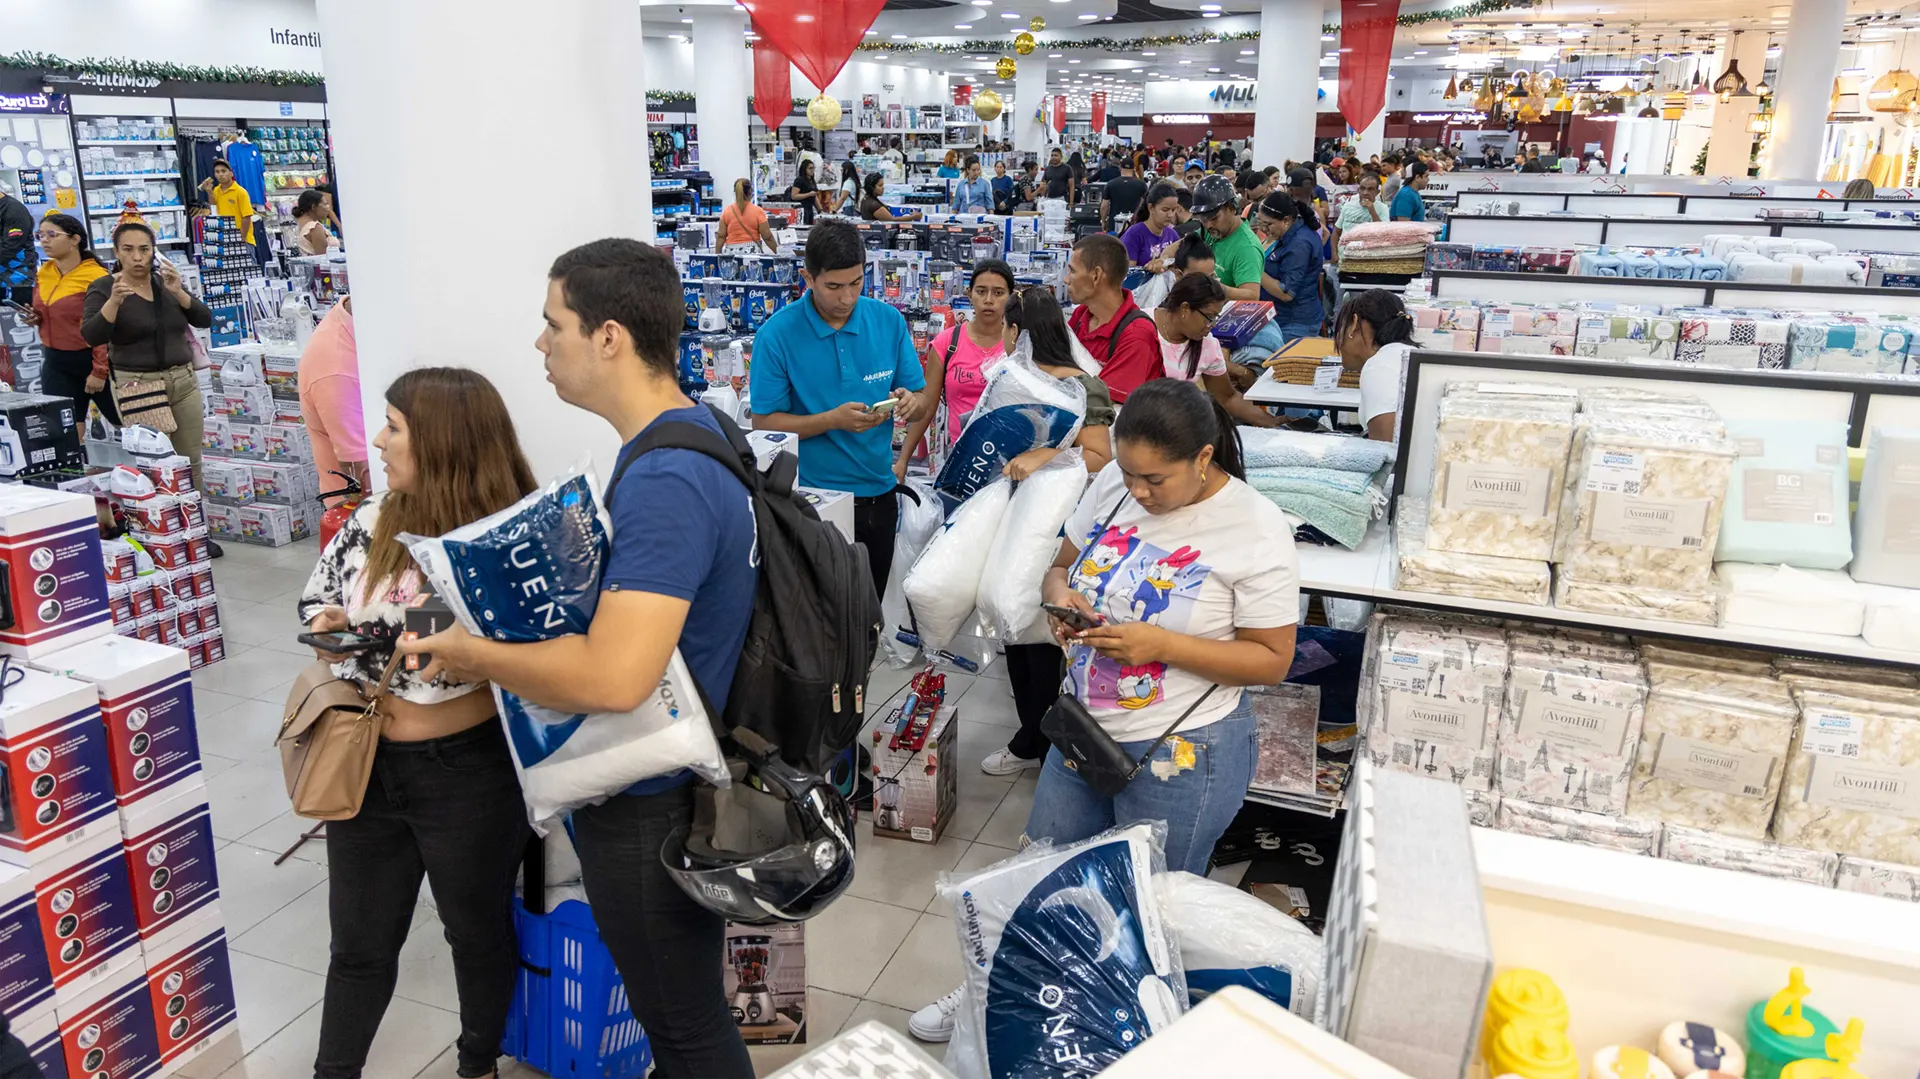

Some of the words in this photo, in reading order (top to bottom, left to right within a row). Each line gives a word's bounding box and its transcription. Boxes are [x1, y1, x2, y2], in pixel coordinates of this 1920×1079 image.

[270, 27, 322, 48] Infantil
[1426, 183, 1449, 191] FRIDAY
[690, 259, 705, 267] Oster
[683, 287, 701, 296] Oster
[749, 289, 767, 299] Oster
[62, 410, 72, 419] 12
[961, 441, 996, 500] UEÑO
[1470, 479, 1521, 493] AvonHill
[1777, 474, 1801, 487] BG
[1628, 509, 1669, 521] AvonHill
[508, 522, 568, 631] SUEÑ
[1409, 709, 1459, 726] AvonHill
[1545, 711, 1598, 730] AvonHill
[1694, 754, 1734, 769] AvonHill
[1838, 776, 1898, 793] AvonHill
[964, 896, 987, 965] MultiMax
